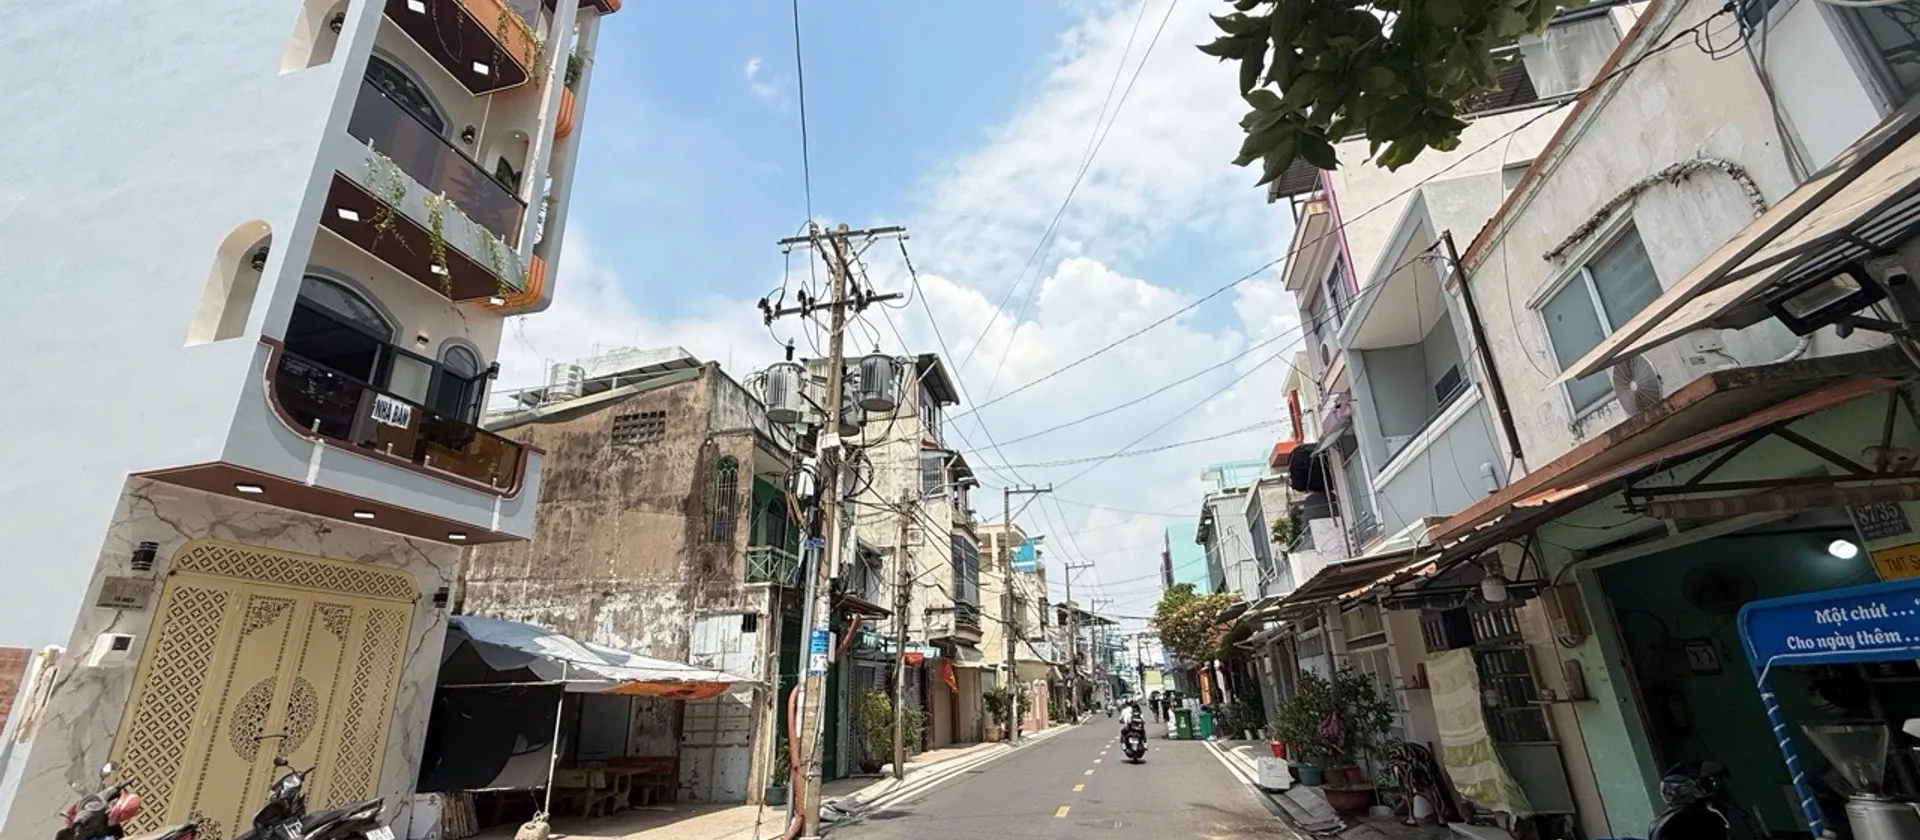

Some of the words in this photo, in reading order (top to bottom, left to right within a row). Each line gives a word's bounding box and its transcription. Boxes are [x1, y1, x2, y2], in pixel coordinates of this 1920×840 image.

[374, 399, 392, 420] NHÀ
[392, 403, 409, 426] BÁN
[1814, 607, 1848, 626] Một
[1850, 602, 1889, 620] chút
[1786, 636, 1815, 650] Cho
[1816, 631, 1855, 651] ngày
[1856, 628, 1902, 646] thêm
